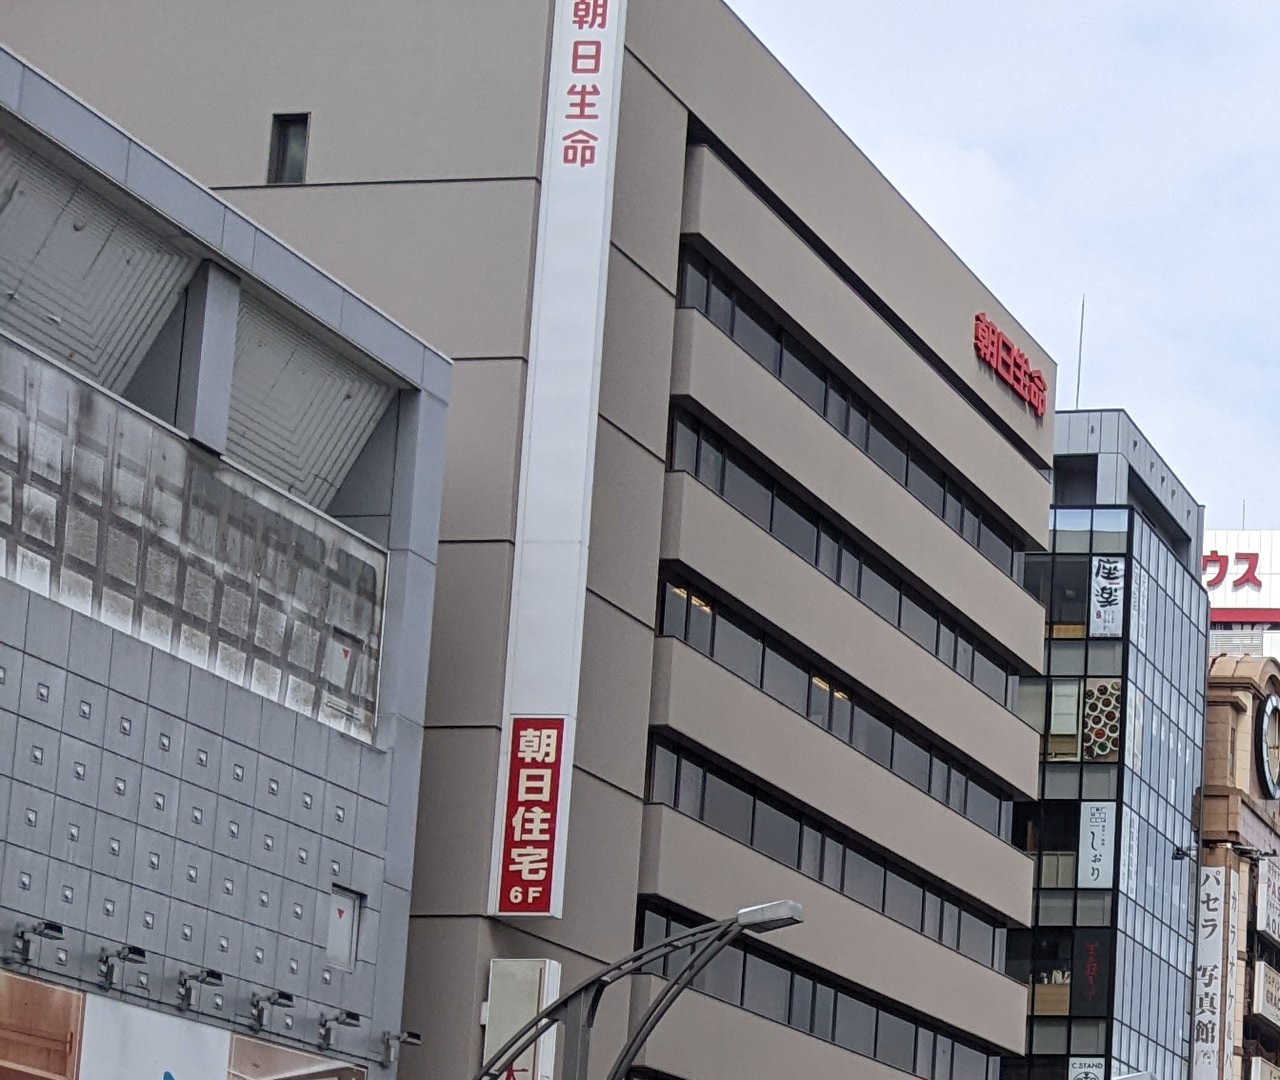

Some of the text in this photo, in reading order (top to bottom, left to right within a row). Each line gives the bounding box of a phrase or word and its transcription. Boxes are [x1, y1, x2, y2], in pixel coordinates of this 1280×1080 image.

[562, 0, 609, 168] 朝日生命
[509, 728, 557, 881] 朝日住宅
[1090, 832, 1103, 882] しおり
[509, 886, 543, 904] 6F
[1200, 870, 1221, 940] パセラ
[1195, 964, 1219, 1044] 写真館
